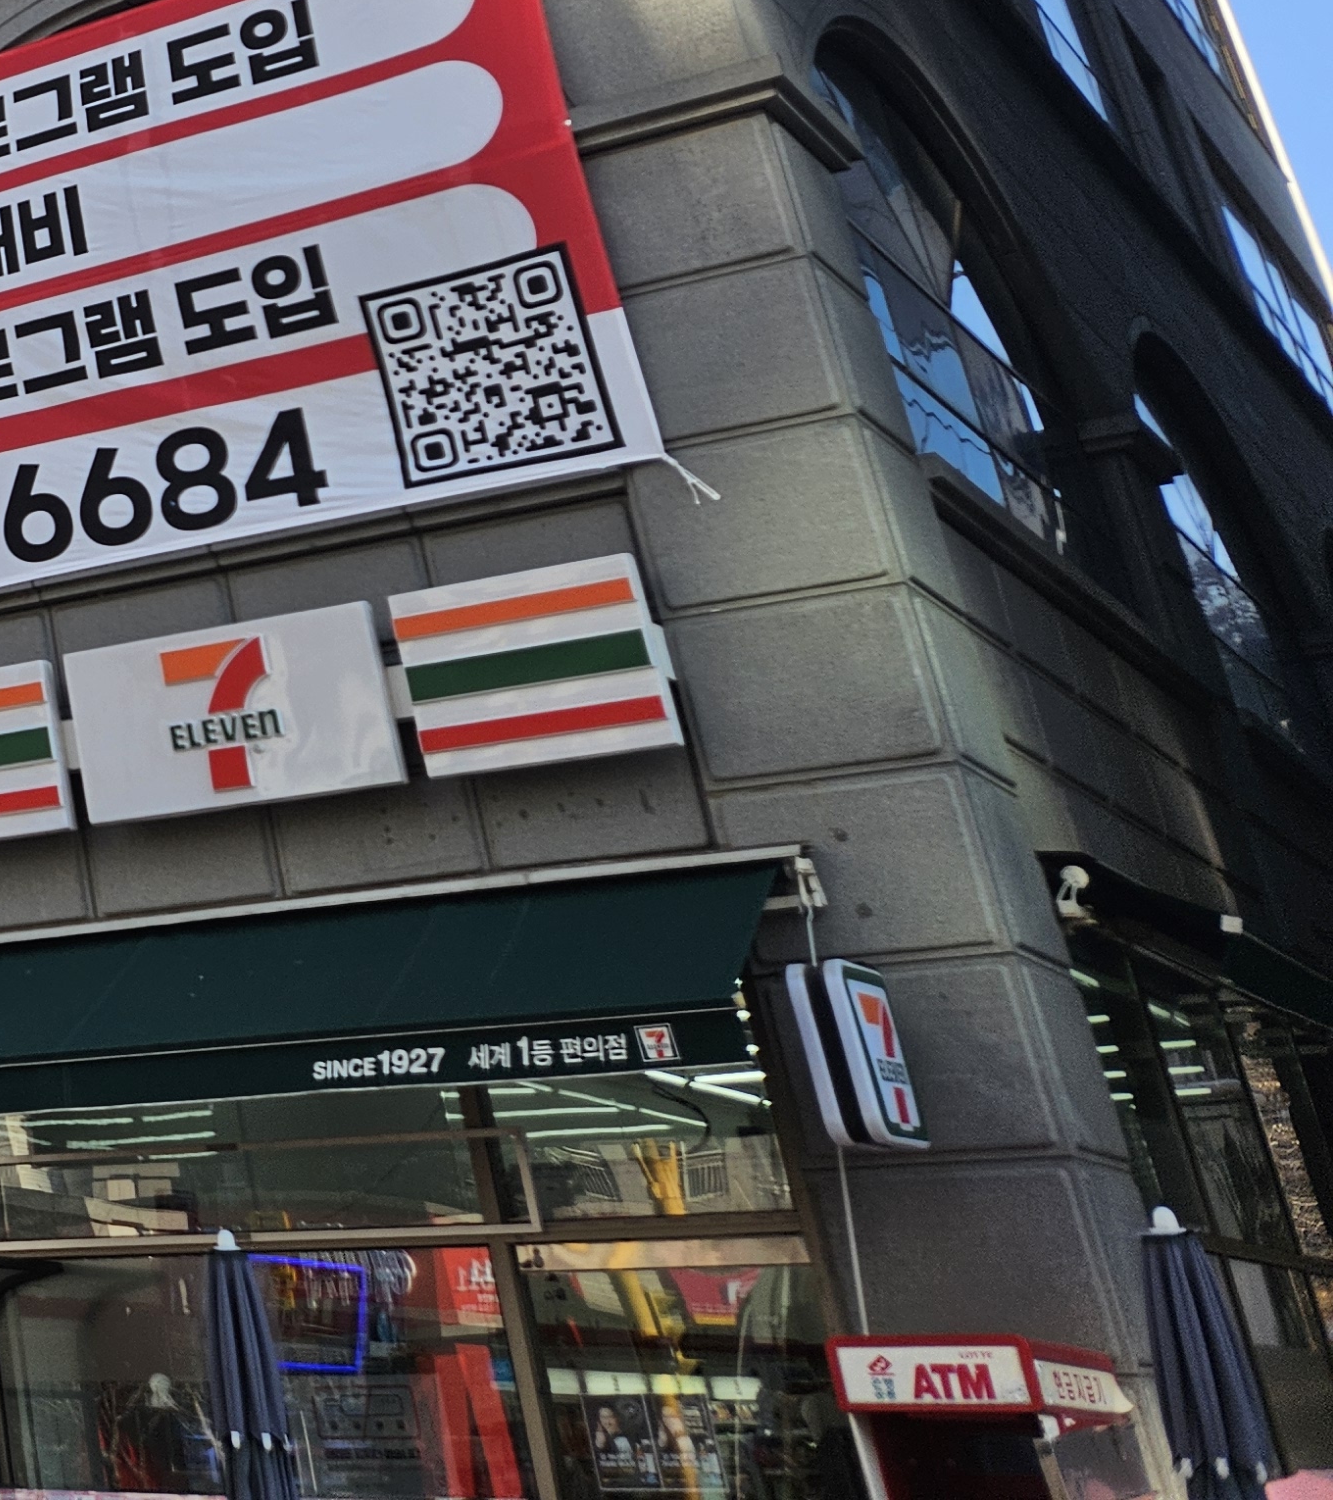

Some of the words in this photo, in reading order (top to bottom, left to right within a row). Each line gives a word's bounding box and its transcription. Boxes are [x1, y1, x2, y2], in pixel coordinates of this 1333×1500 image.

[172, 242, 339, 359] 도입
[311, 1053, 377, 1083] SINCE
[376, 1045, 446, 1076] 1927
[466, 1039, 512, 1071] 세계
[515, 1035, 556, 1069] 1등
[559, 1031, 630, 1066] 편의점
[912, 1362, 998, 1401] ATM
